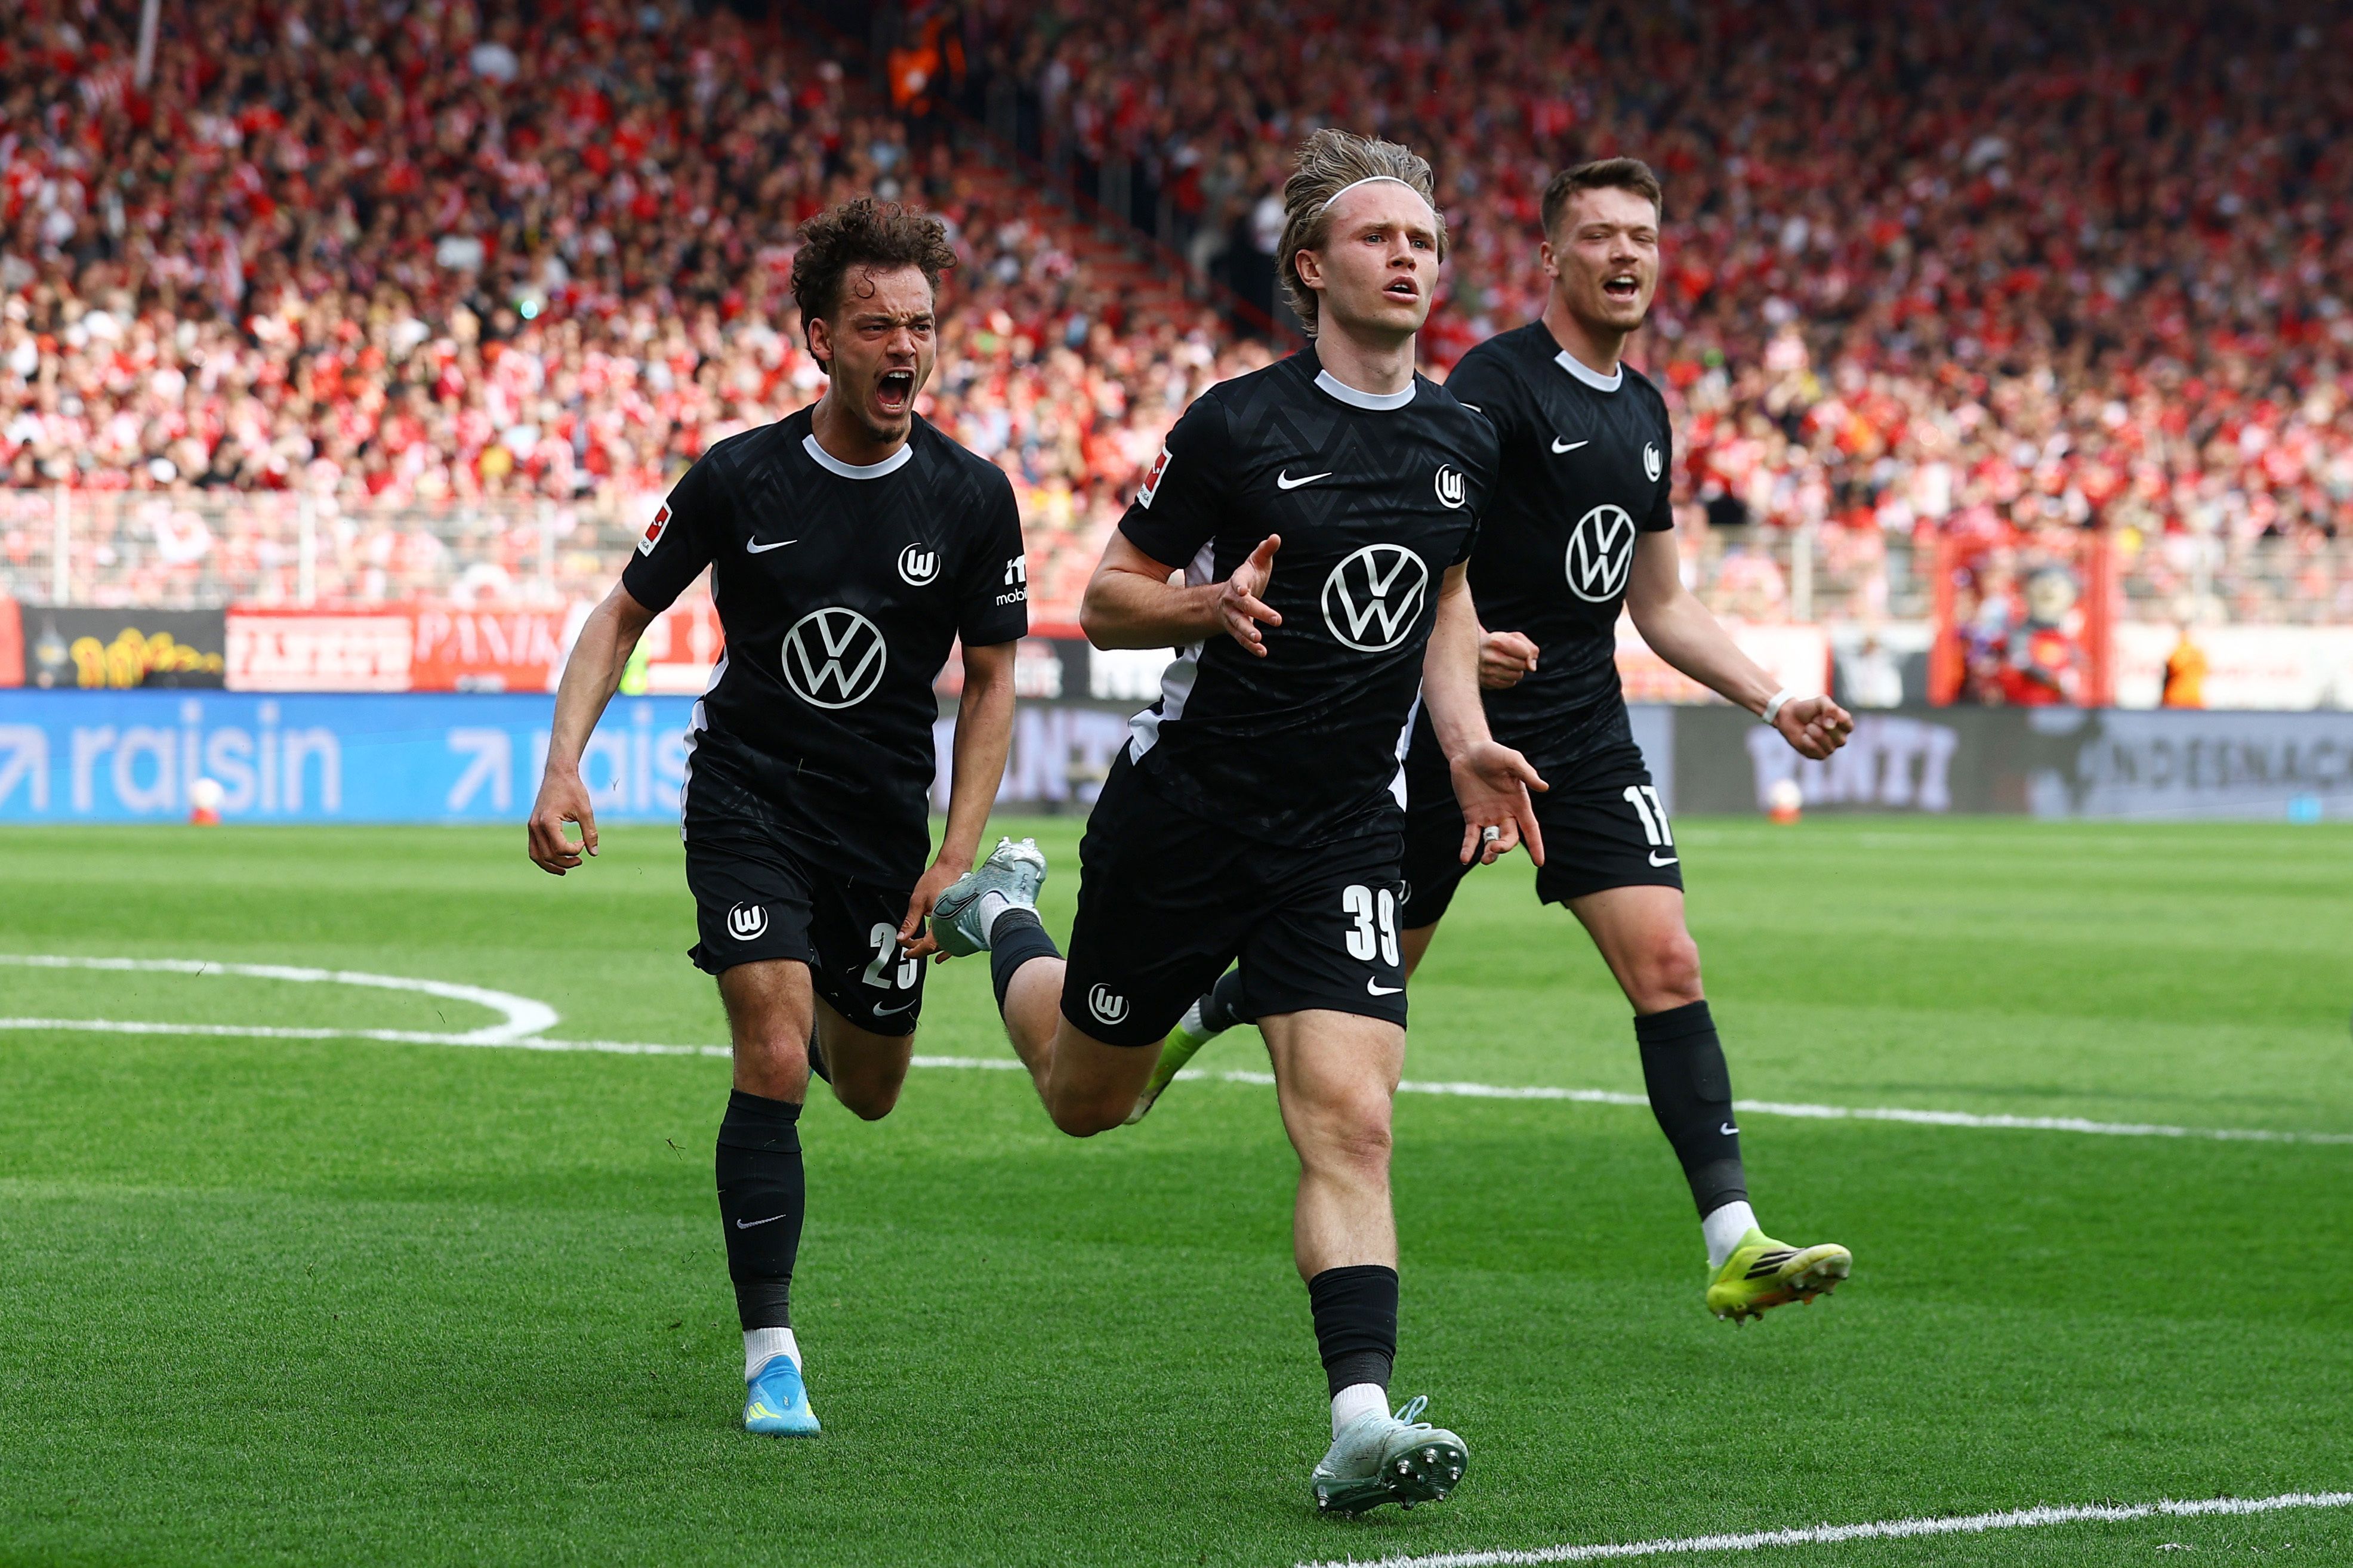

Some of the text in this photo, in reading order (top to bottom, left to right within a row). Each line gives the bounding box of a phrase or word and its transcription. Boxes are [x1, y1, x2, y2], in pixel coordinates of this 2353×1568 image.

[1325, 546, 1426, 647] VW
[787, 609, 884, 703] VW
[71, 698, 341, 813] raisin
[862, 922, 918, 989] 25
[1343, 885, 1399, 967] 39
